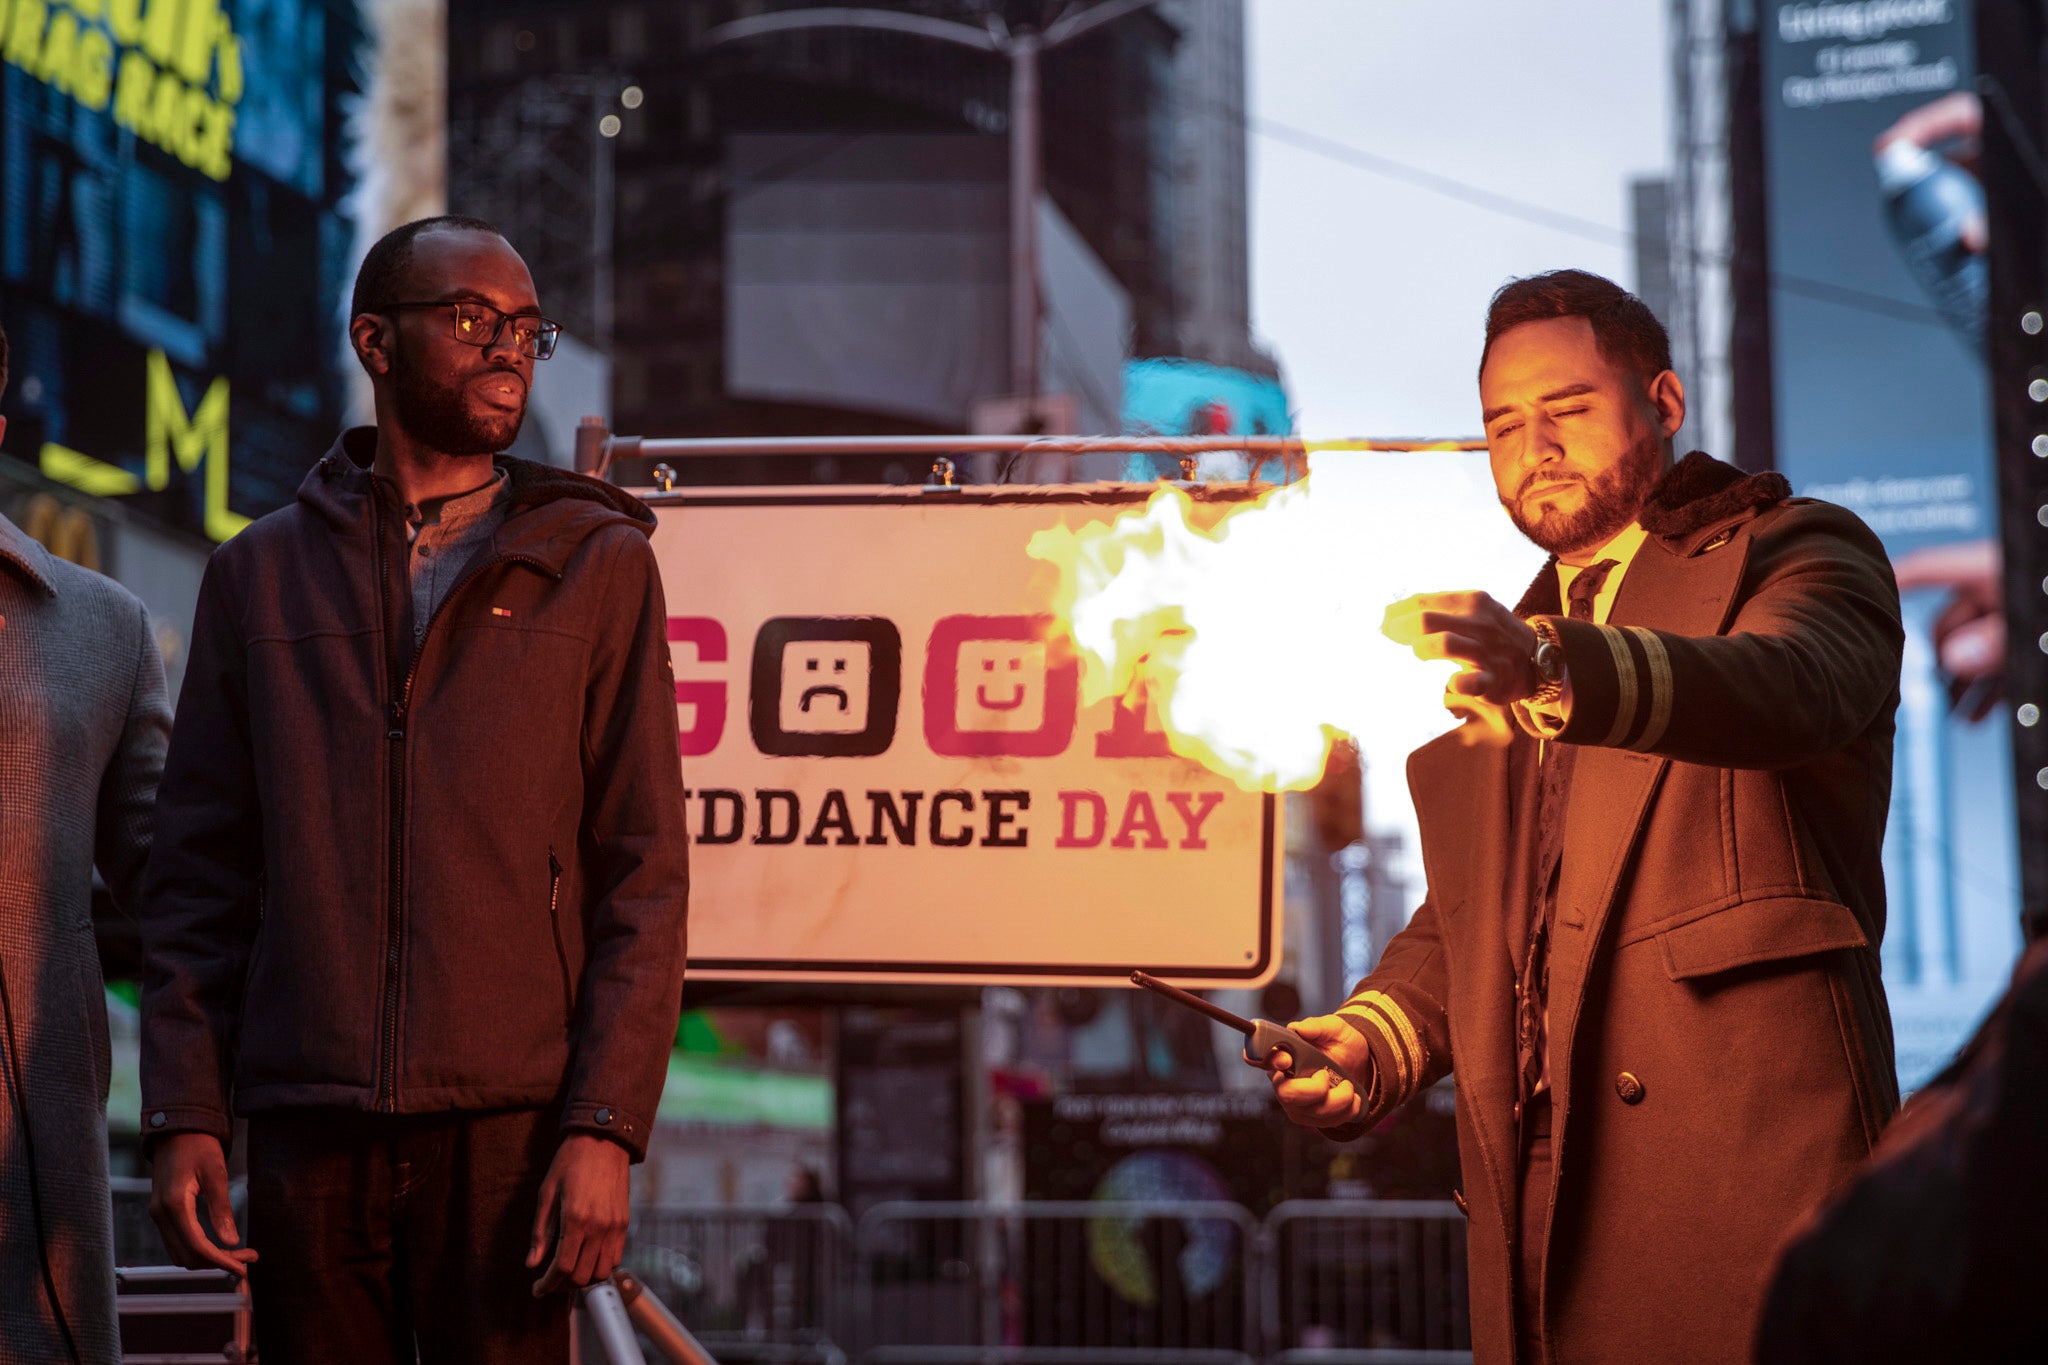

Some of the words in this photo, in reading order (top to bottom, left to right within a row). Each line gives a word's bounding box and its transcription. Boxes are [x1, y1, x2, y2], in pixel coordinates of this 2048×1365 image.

[0, 0, 112, 112] RAG
[686, 788, 1031, 848] DDANCE
[1055, 790, 1224, 850] DAY
